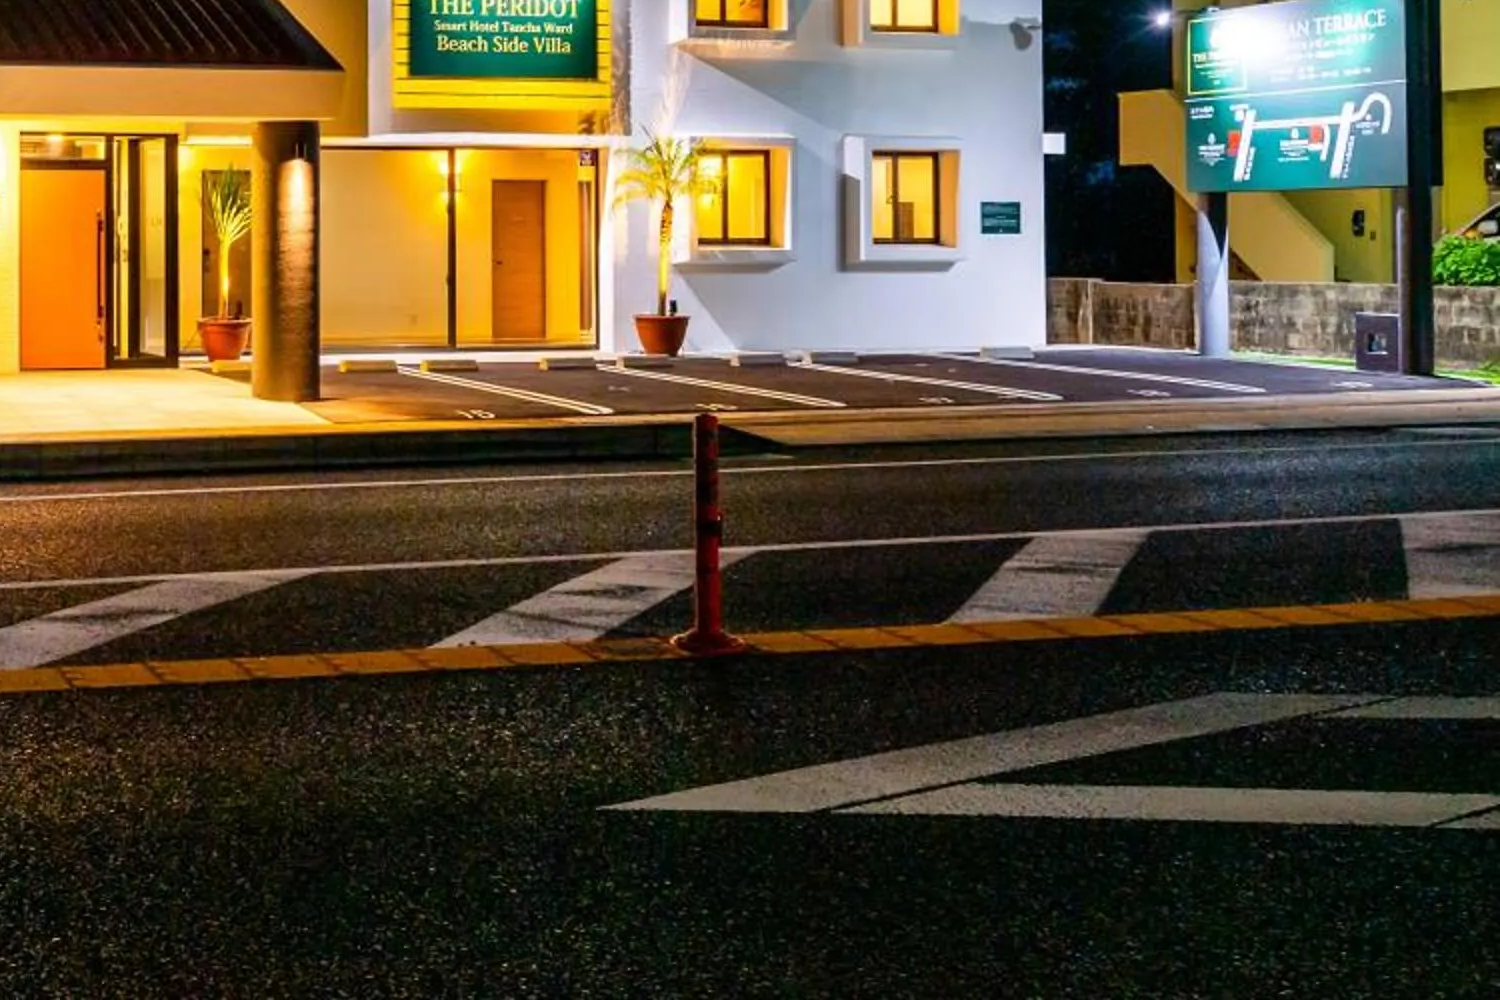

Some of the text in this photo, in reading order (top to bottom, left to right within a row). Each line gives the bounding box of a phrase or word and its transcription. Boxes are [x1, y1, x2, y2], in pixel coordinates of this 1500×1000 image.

[434, 20, 467, 32] Smart
[469, 20, 499, 33] Hotel
[1312, 8, 1386, 35] TERRACE
[436, 34, 571, 54] Beach Side Villa
